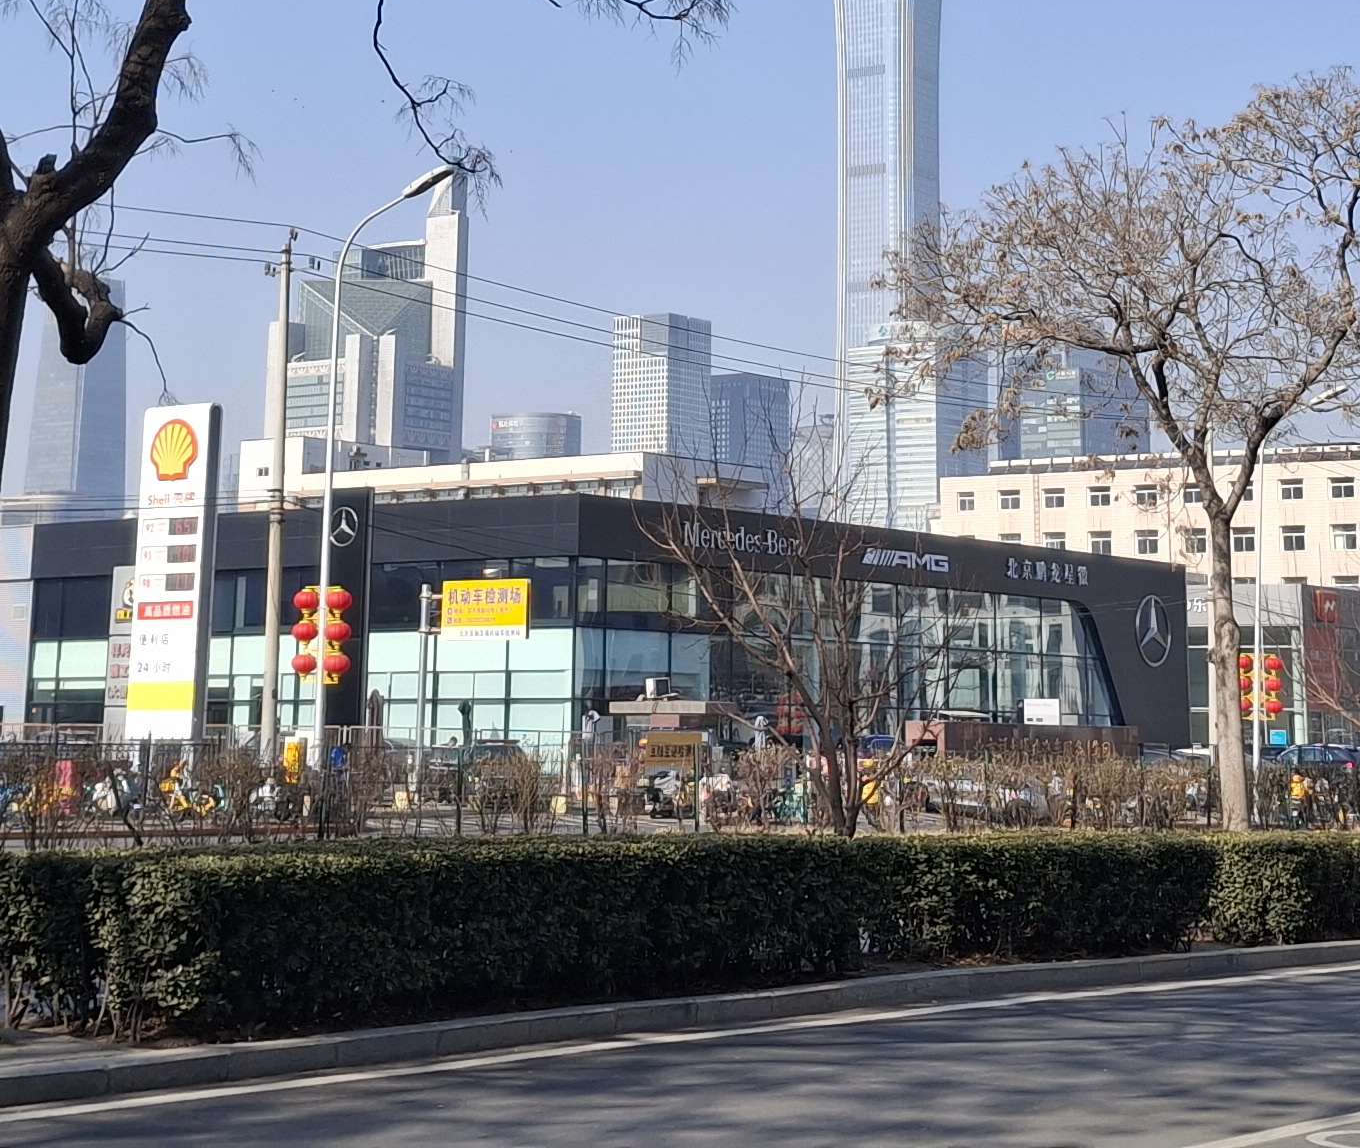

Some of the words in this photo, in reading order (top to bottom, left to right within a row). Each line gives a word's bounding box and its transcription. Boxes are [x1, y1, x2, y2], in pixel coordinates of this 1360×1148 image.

[147, 494, 171, 506] Shell
[173, 492, 196, 504] 壳牌
[448, 586, 522, 605] 机动车检测场
[143, 603, 191, 618] 高品质燃油
[138, 633, 170, 646] 便利店
